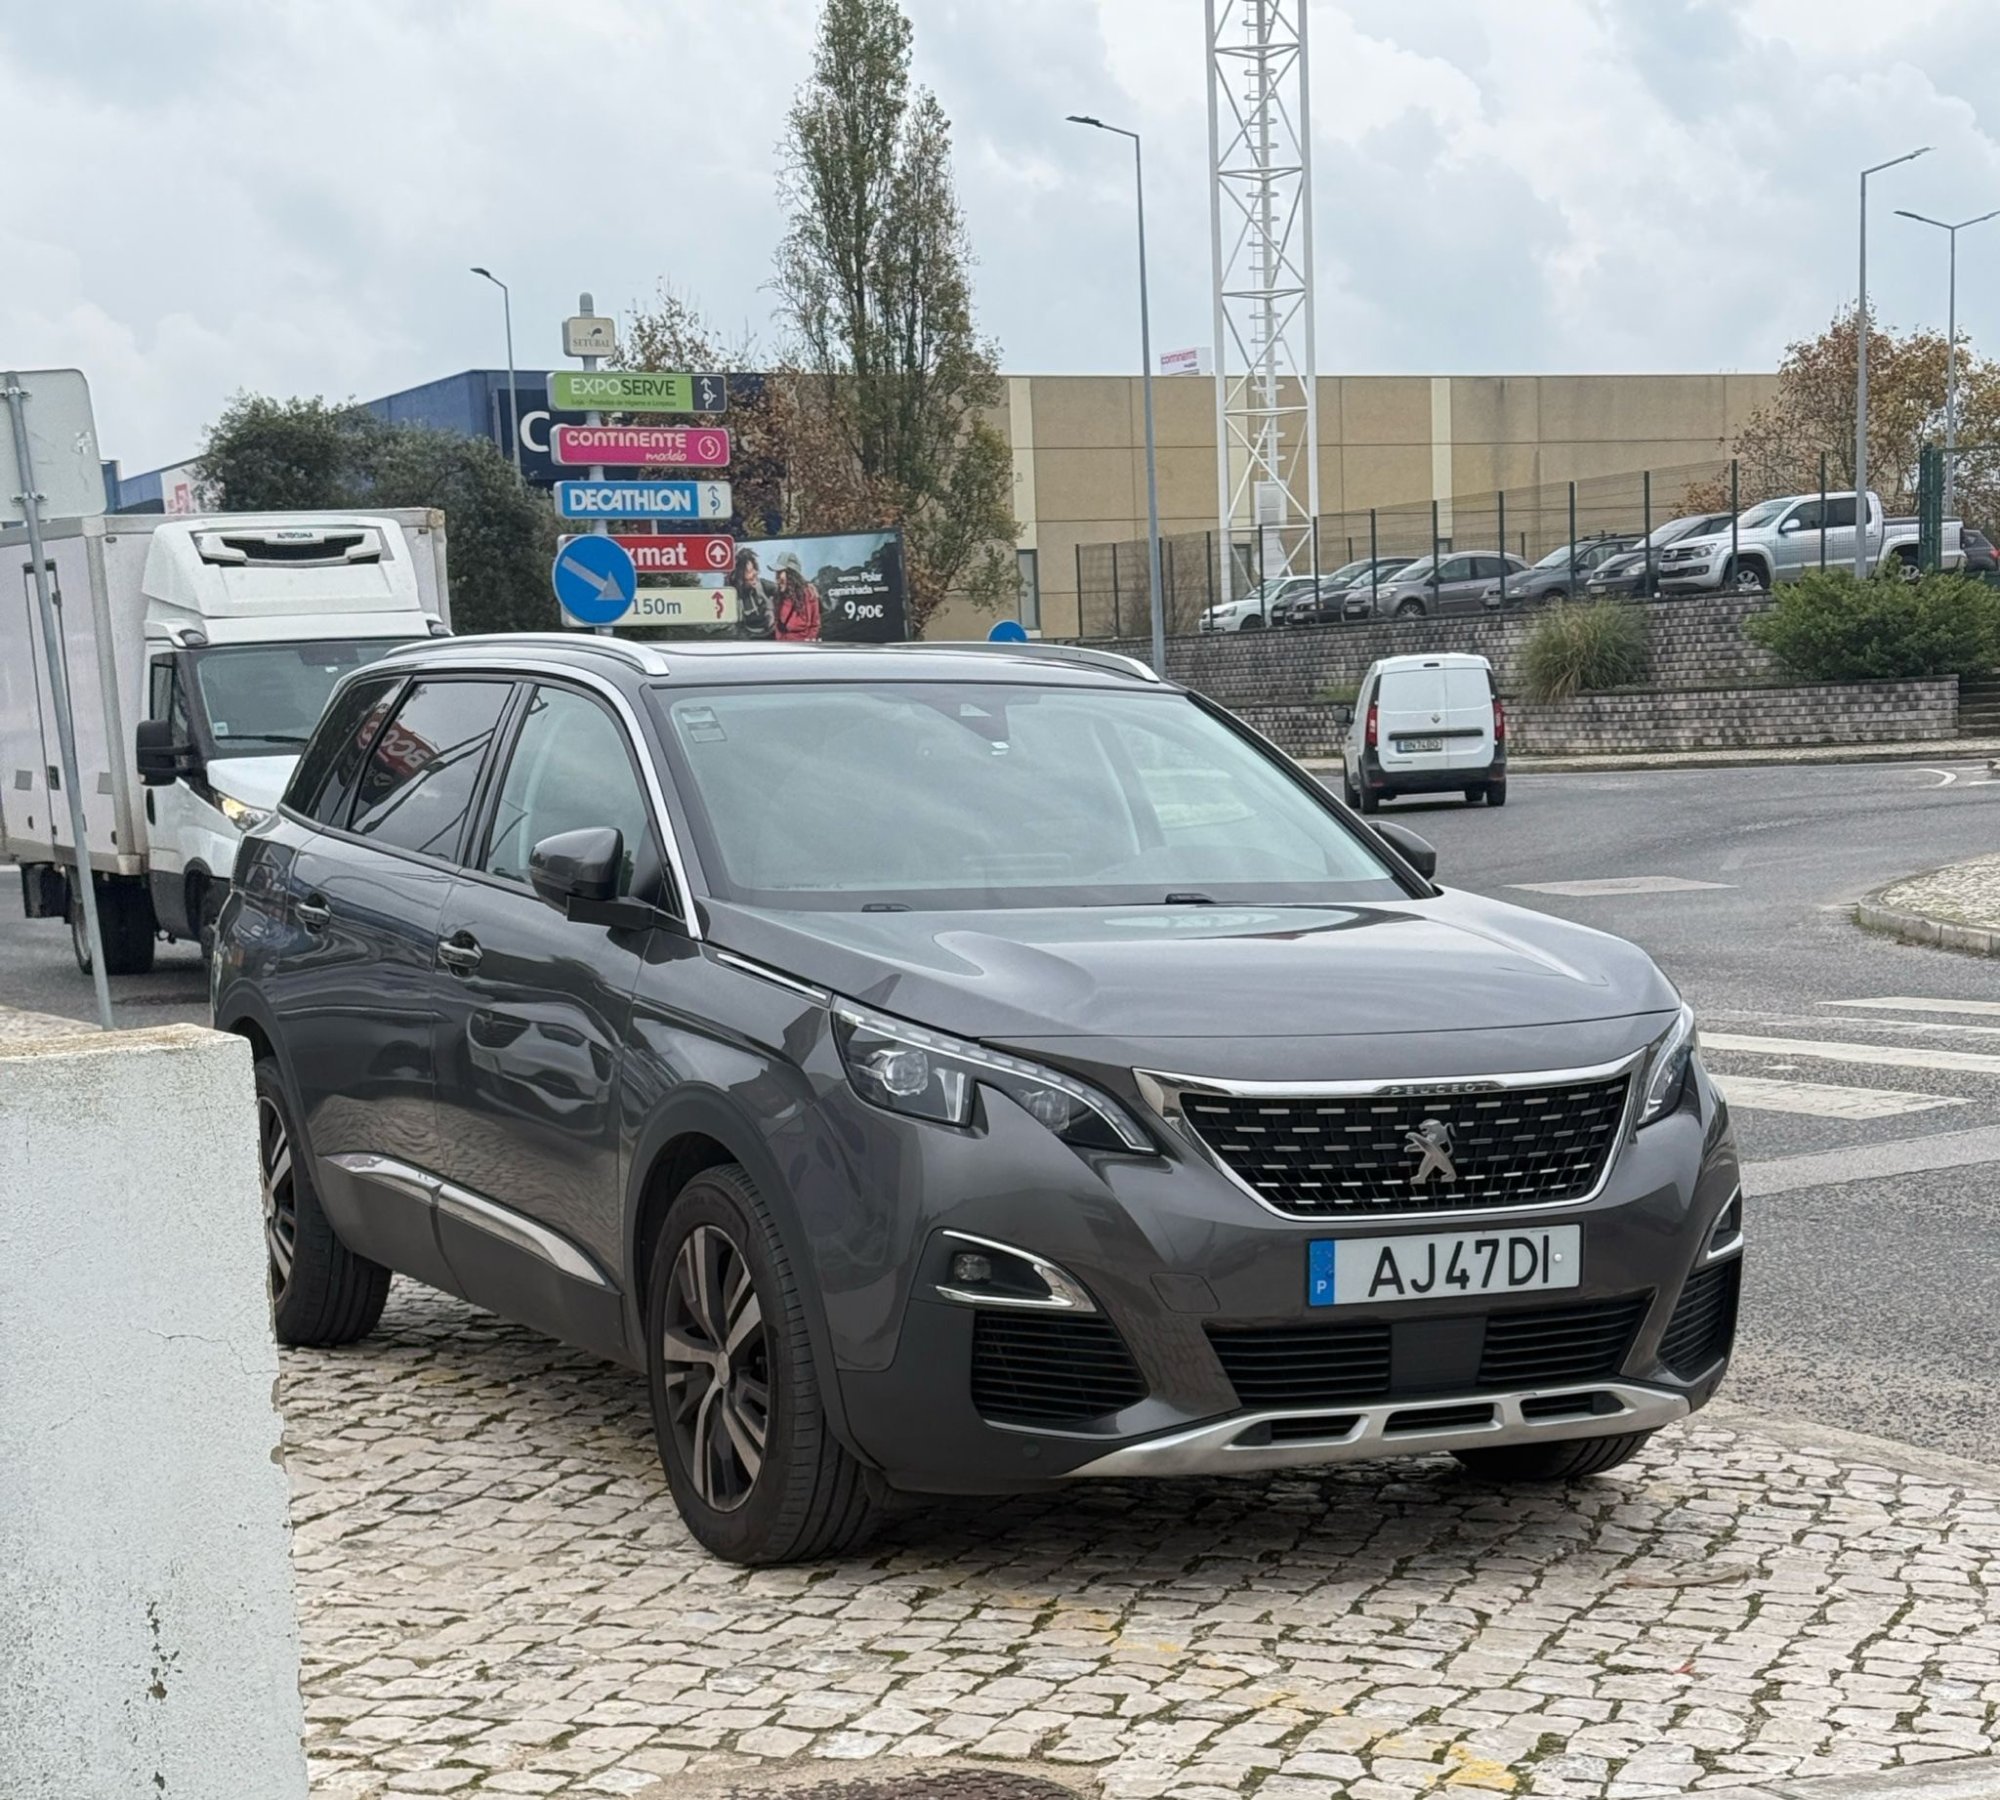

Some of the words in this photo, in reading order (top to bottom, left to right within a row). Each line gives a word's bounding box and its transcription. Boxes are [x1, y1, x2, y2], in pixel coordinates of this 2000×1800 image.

[570, 378, 676, 396] EXPOSERVE
[566, 431, 687, 448] CONTINENTE
[645, 450, 687, 462] modelo
[569, 489, 692, 511] DECATHLON
[633, 599, 682, 615] 150m
[844, 600, 884, 622] 9,90€
[1368, 1235, 1549, 1297] AJ47DI
[1316, 1280, 1327, 1294] P
